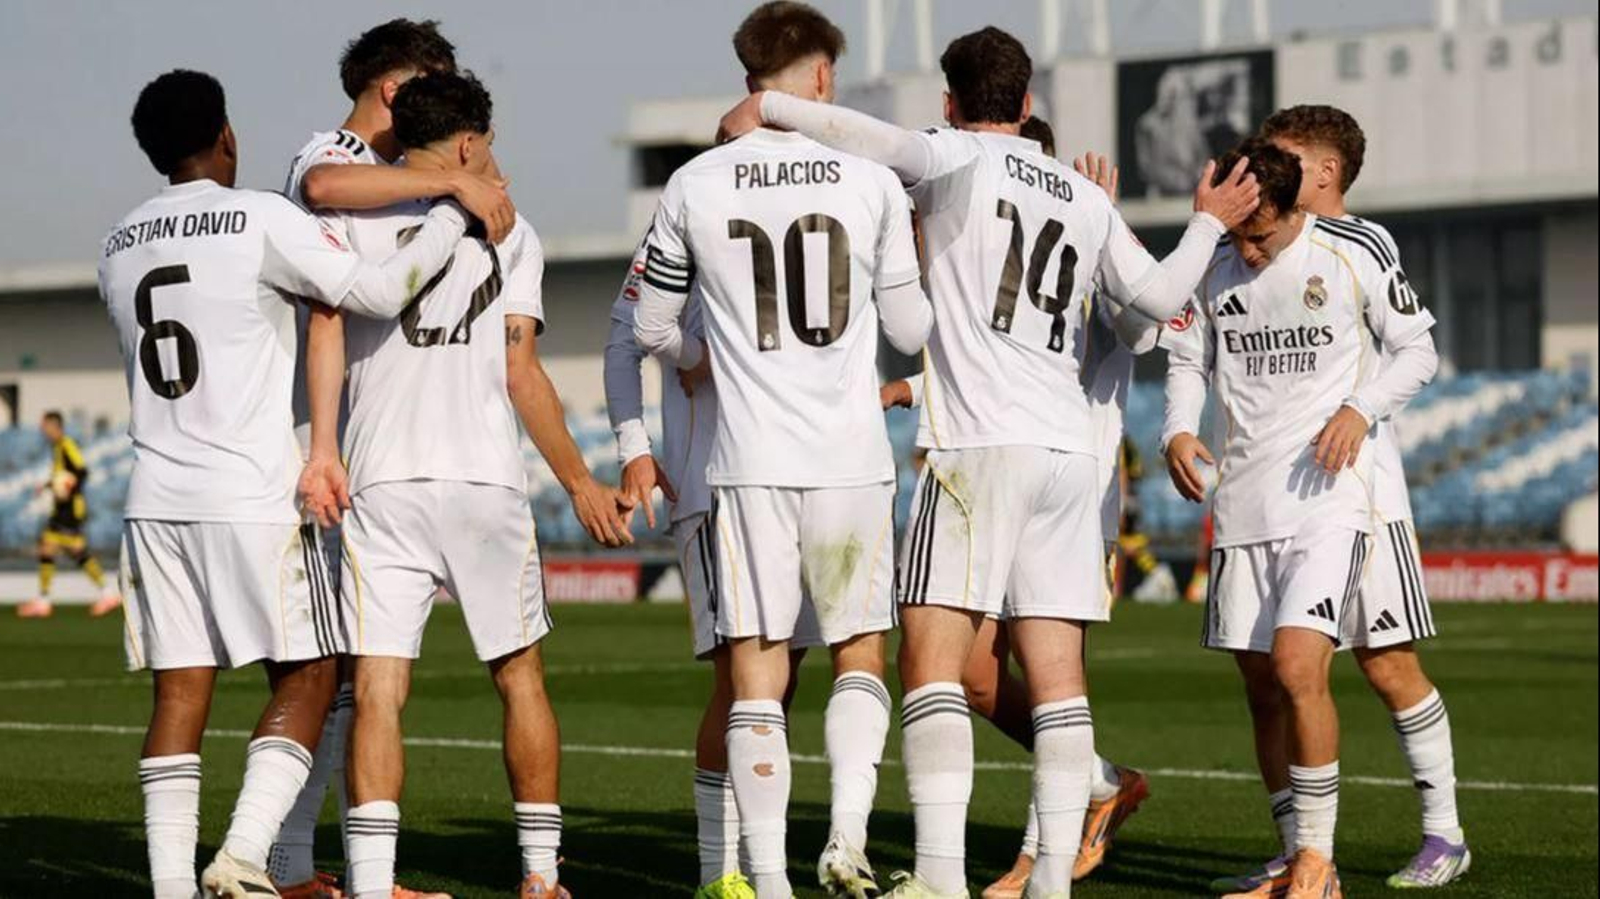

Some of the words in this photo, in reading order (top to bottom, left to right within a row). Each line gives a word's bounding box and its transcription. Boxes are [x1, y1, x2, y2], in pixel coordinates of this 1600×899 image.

[734, 160, 842, 190] PALACIOS
[1005, 153, 1074, 202] CESTERO
[182, 210, 246, 237] DAVID
[727, 212, 852, 352] 10
[990, 198, 1079, 353] 14
[134, 264, 199, 400] 6
[1223, 324, 1334, 353] Emirates
[1246, 356, 1265, 376] FLY
[1268, 351, 1317, 376] BETTER
[1423, 558, 1540, 601] mirates
